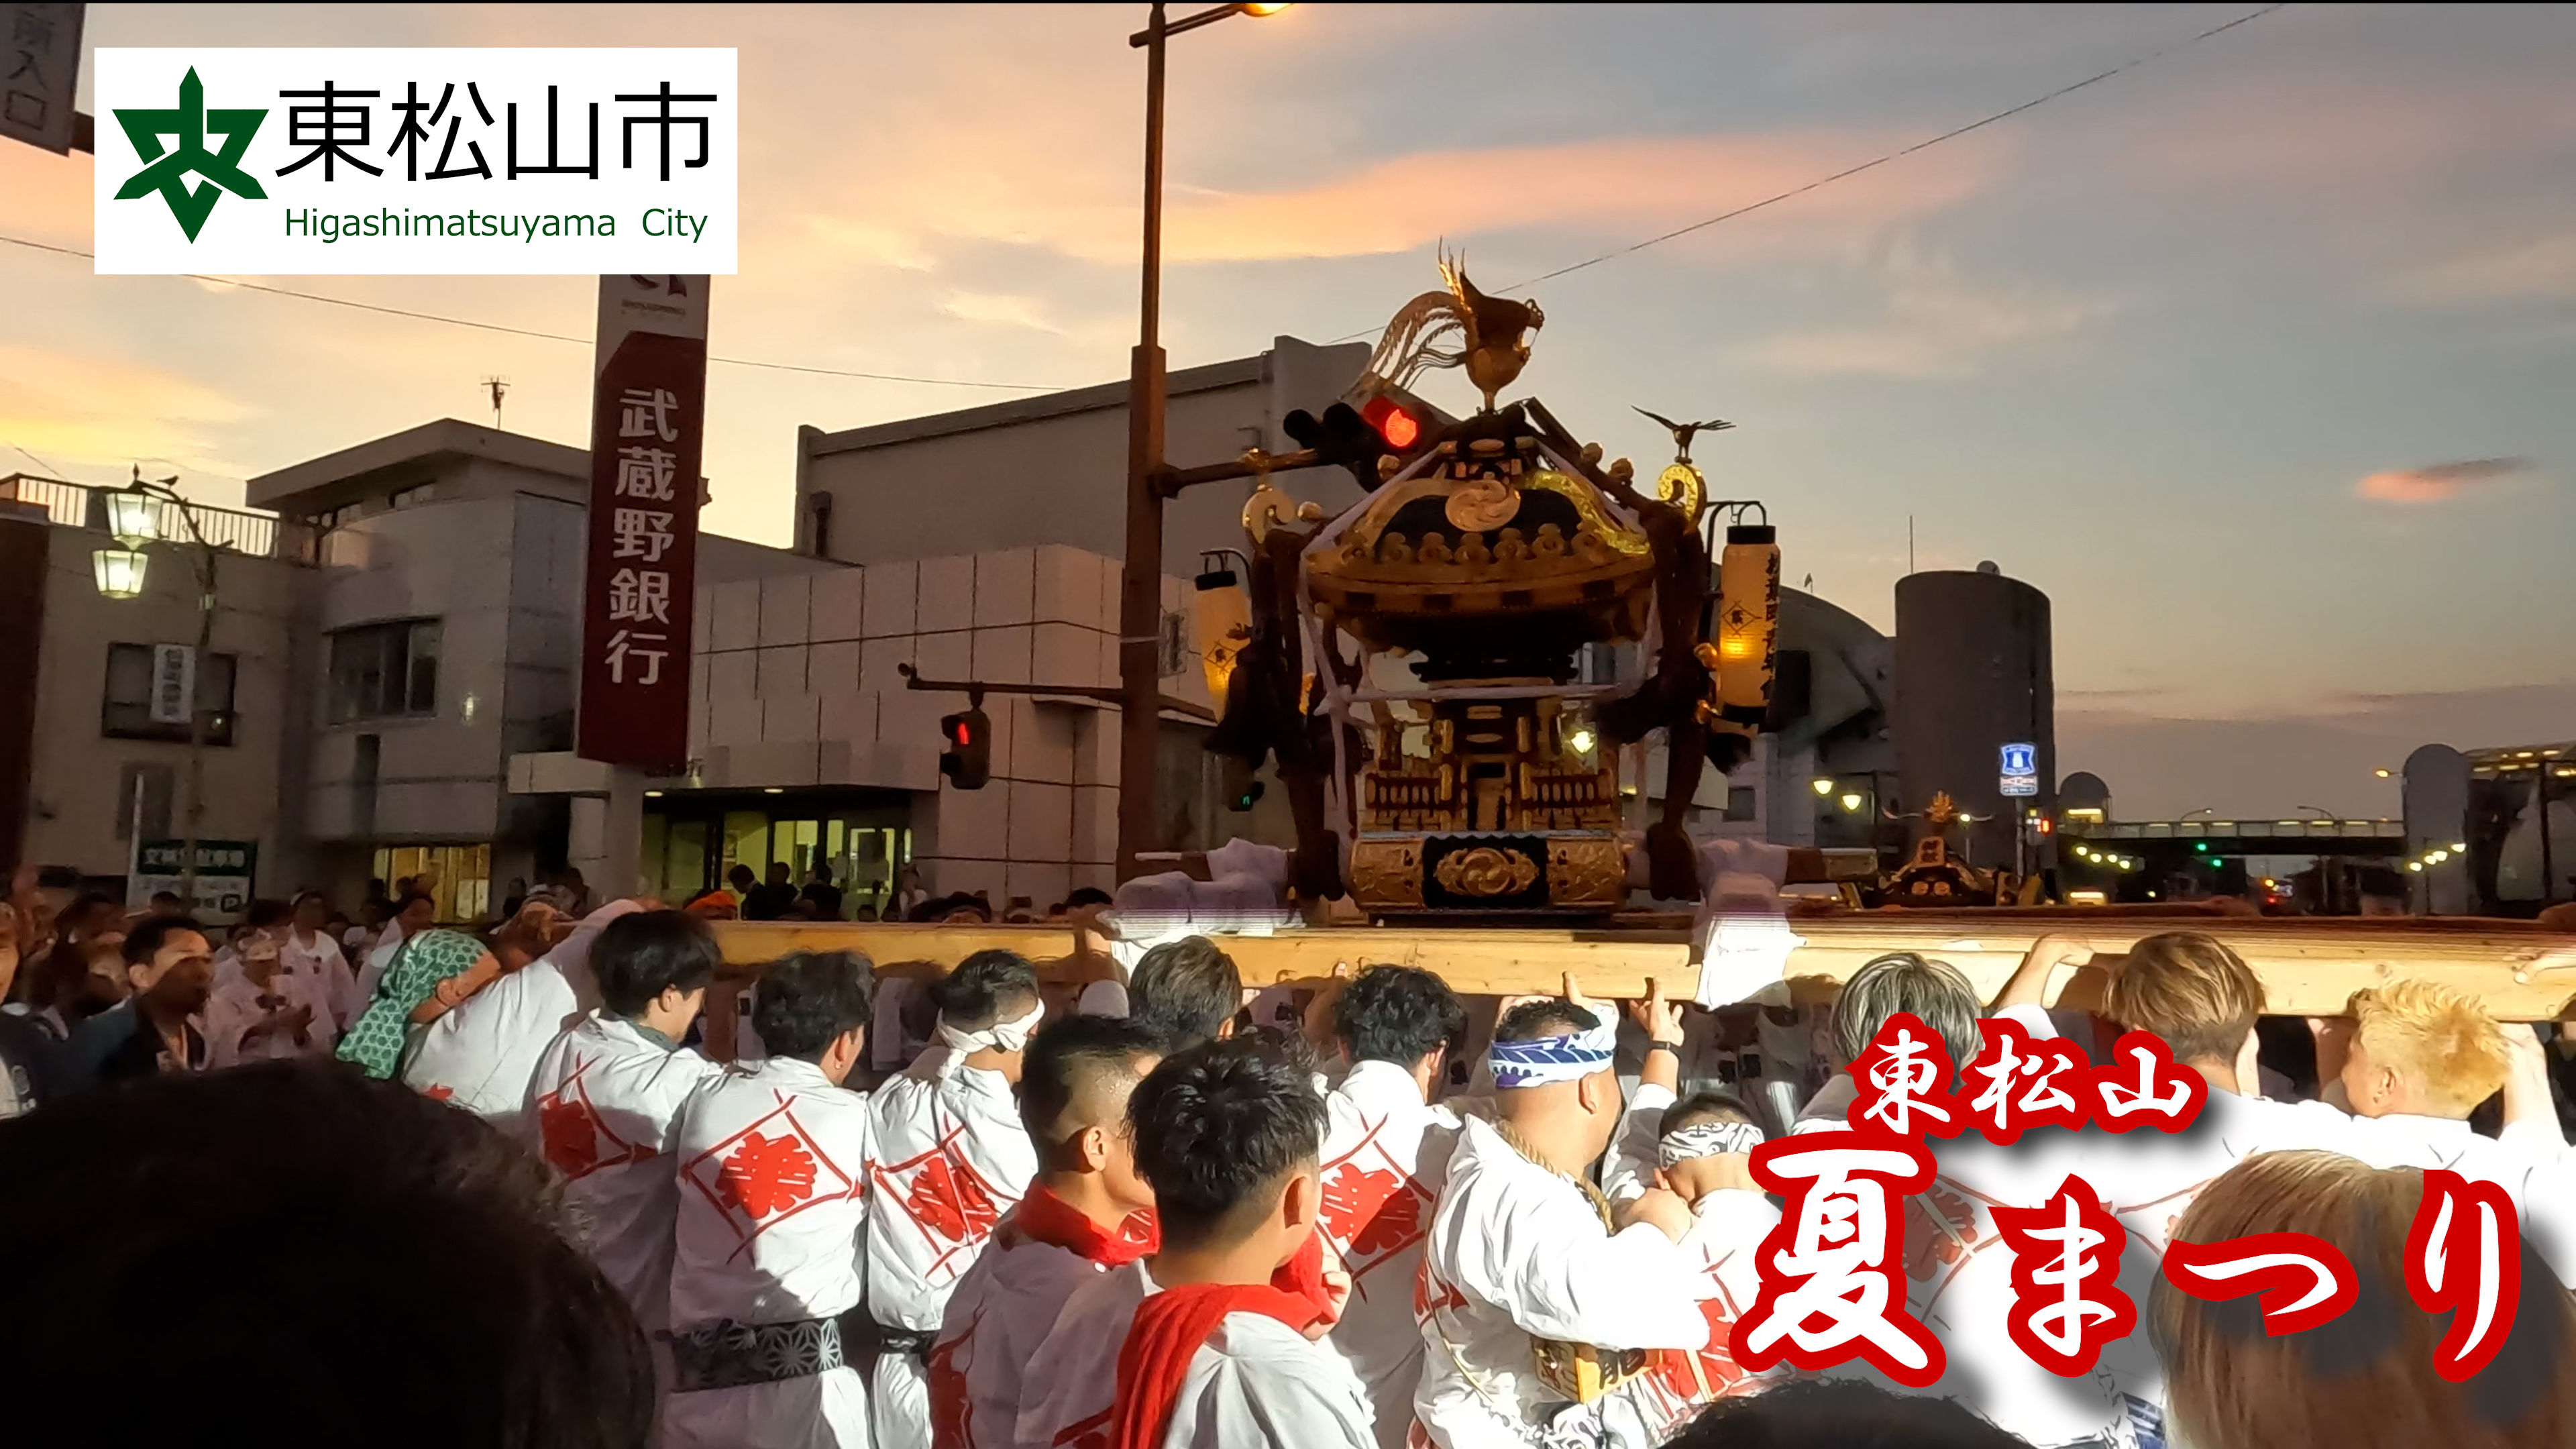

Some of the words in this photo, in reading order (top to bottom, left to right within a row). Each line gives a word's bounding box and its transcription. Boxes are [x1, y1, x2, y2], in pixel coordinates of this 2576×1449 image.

[604, 387, 680, 687] 武蔵野銀行
